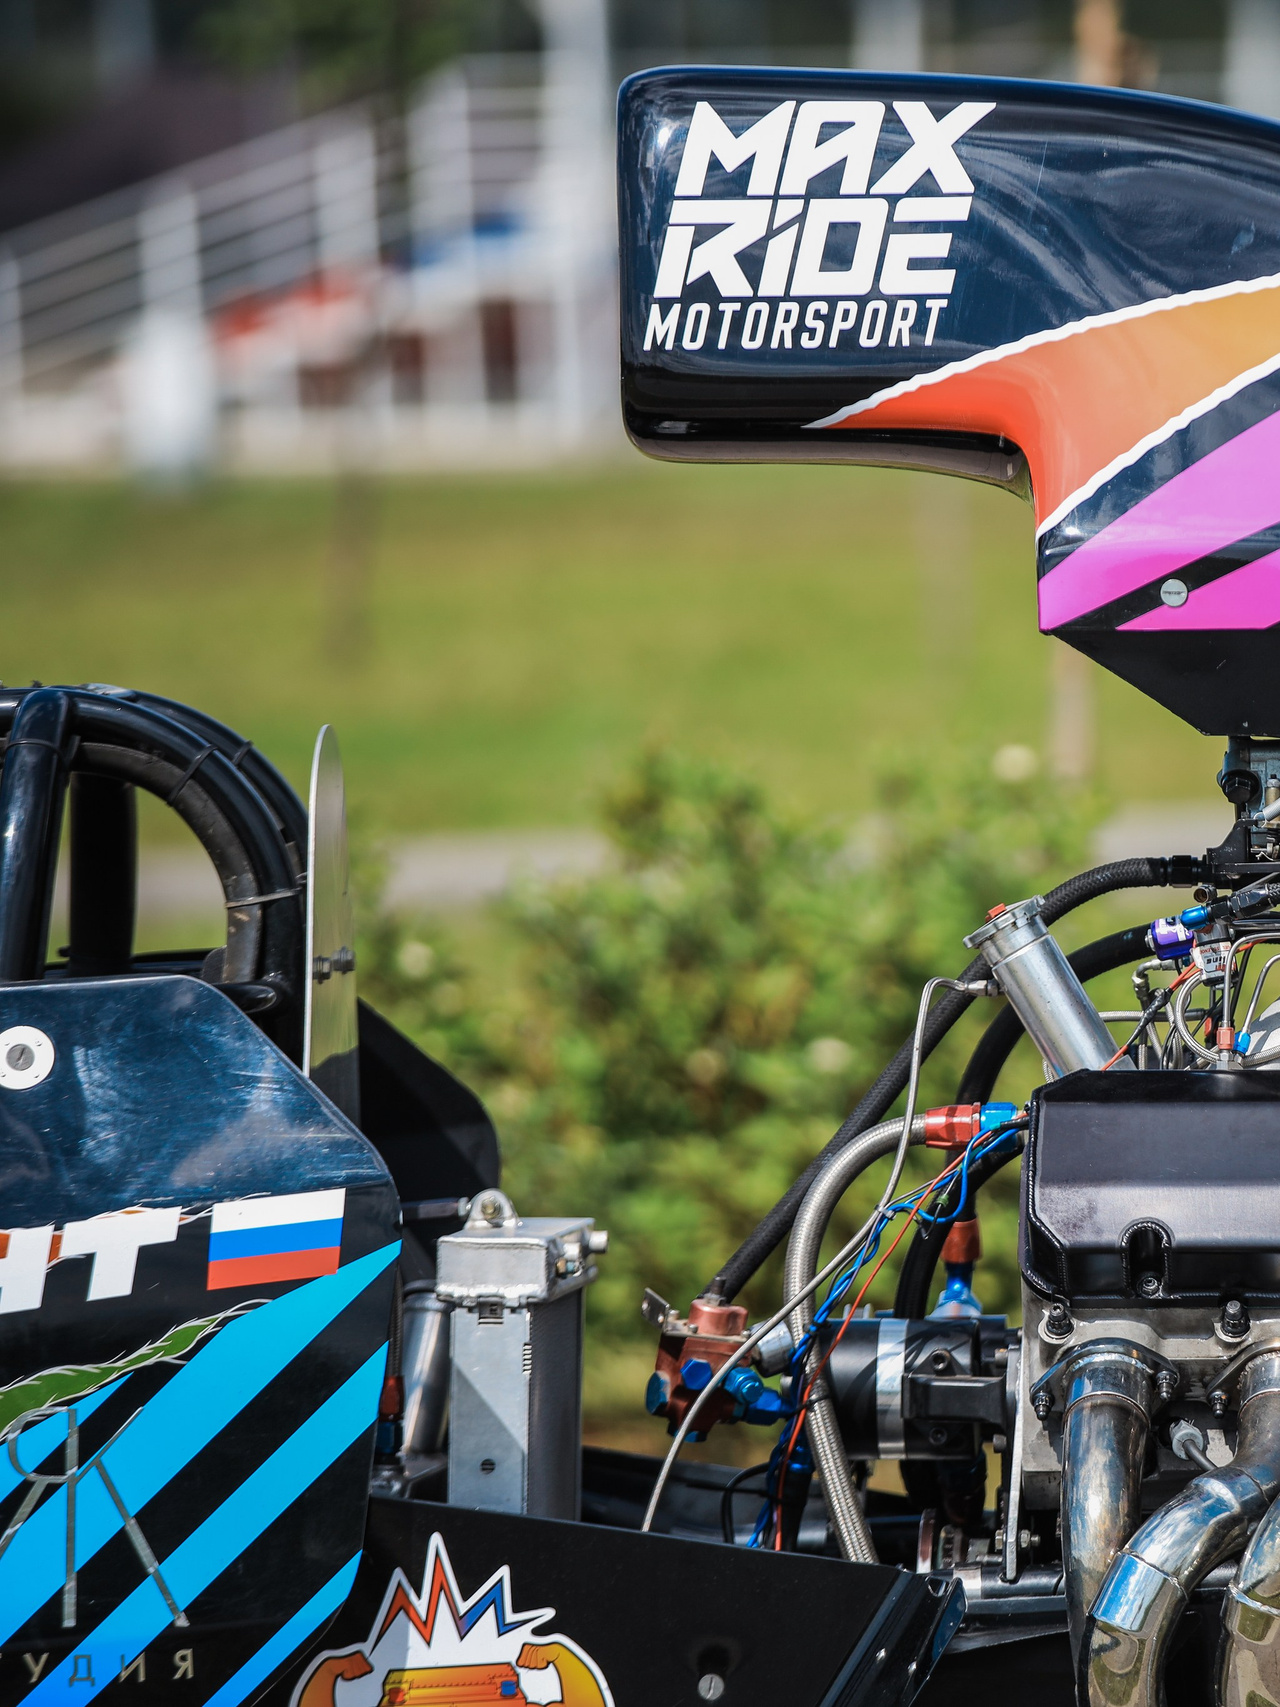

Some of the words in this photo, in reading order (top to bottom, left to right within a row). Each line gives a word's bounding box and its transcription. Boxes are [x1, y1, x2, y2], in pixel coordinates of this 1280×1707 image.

[674, 100, 997, 197] MAX
[642, 298, 949, 352] MOTORSPORT
[0, 1648, 195, 1687] УДИЯ
